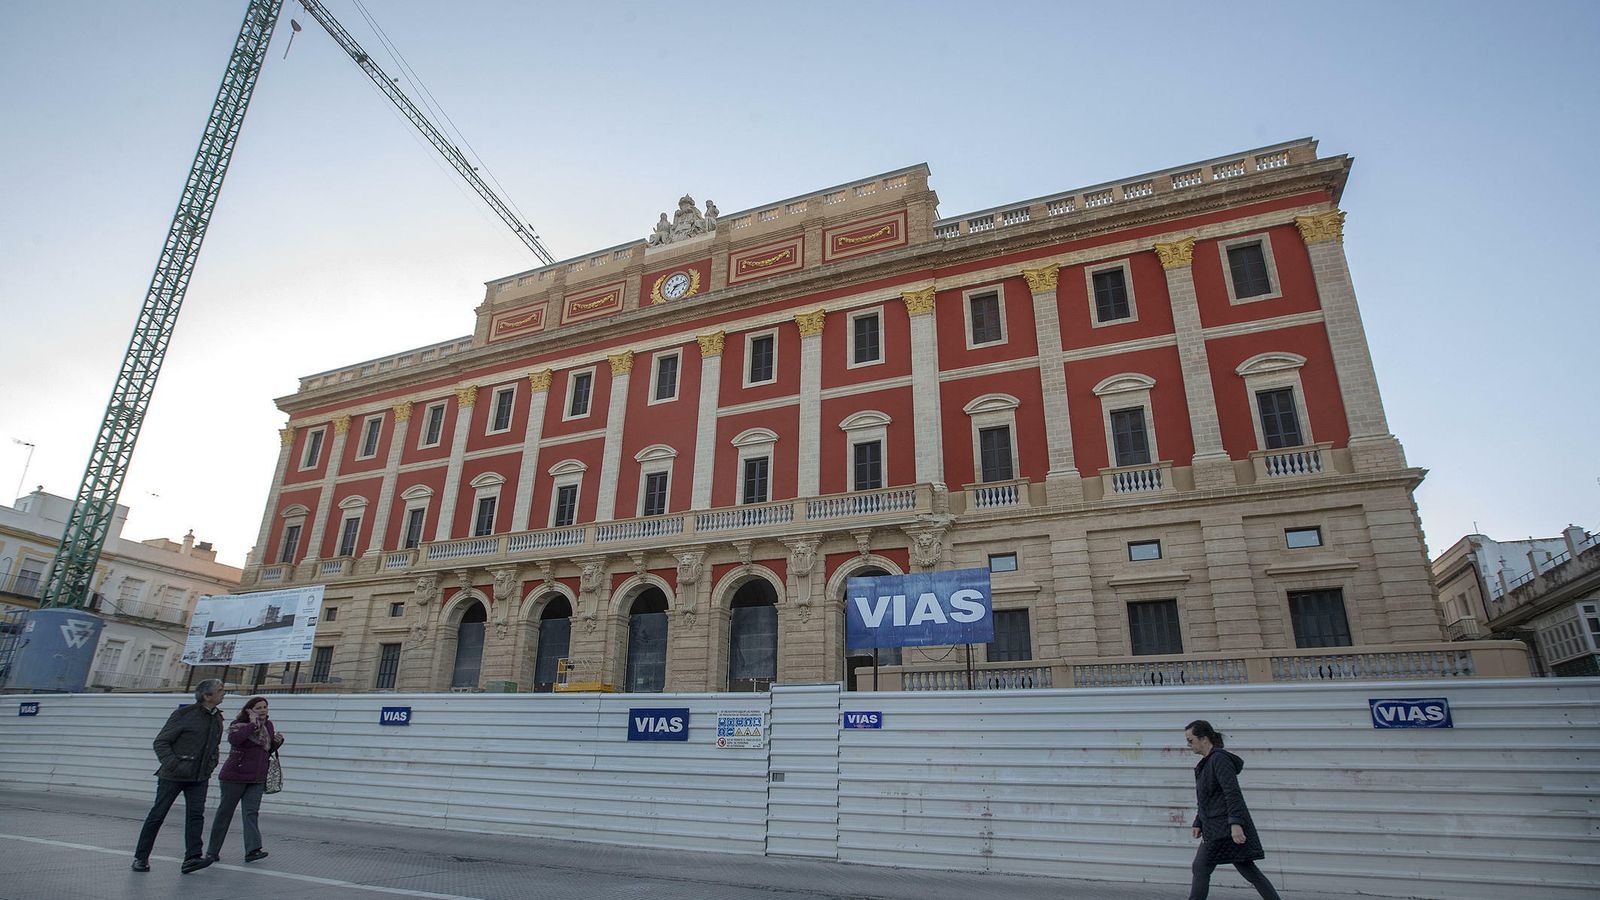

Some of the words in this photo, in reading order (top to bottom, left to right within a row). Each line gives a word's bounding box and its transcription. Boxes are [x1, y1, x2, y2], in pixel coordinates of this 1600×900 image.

[854, 588, 986, 628] VIAS
[20, 705, 36, 714] VIAS
[383, 711, 407, 721] VIAS
[1377, 705, 1444, 722] VIAS
[634, 716, 683, 733] VIAS
[847, 714, 878, 724] VIAS
